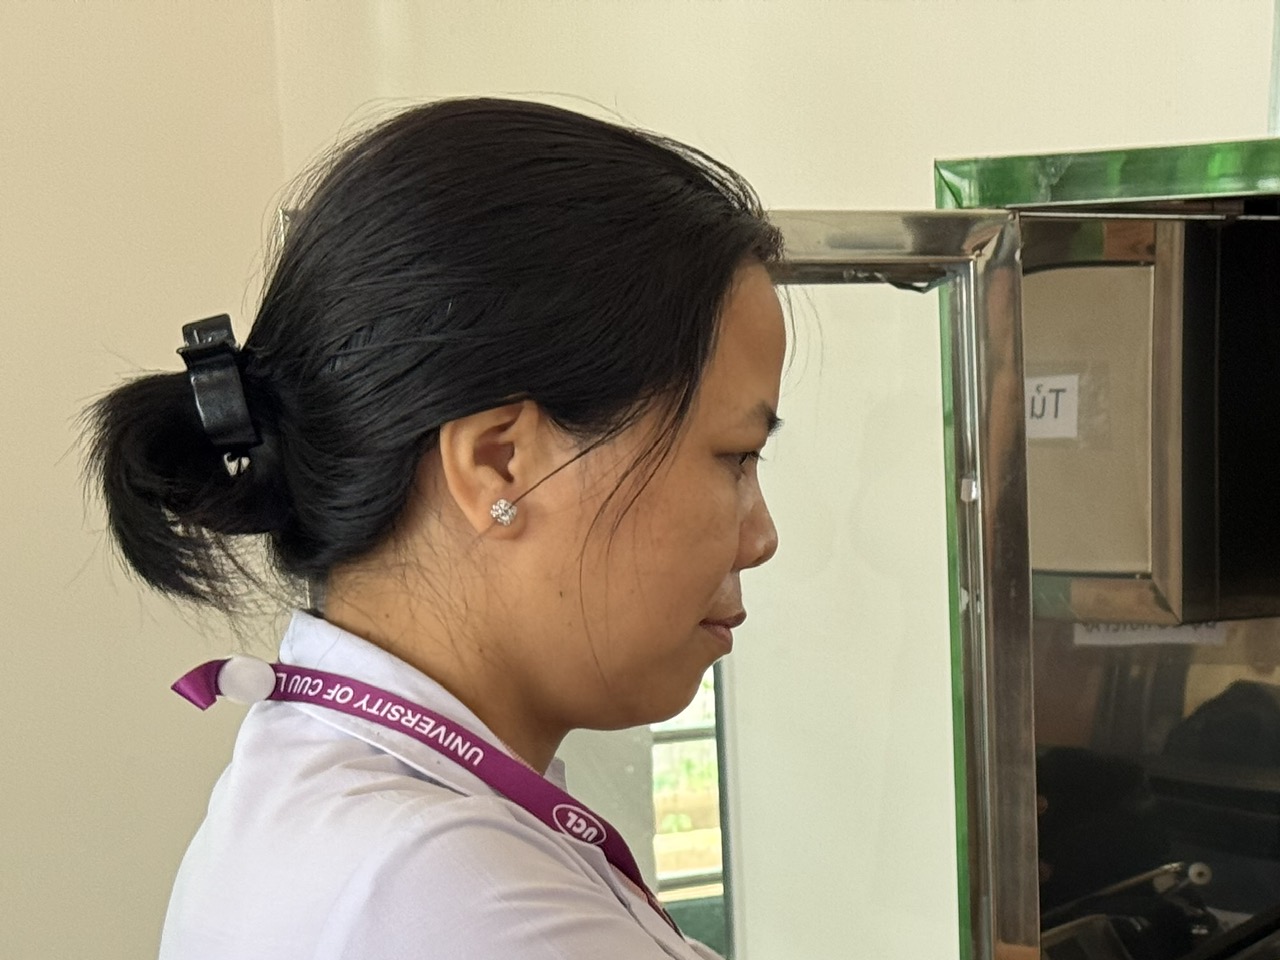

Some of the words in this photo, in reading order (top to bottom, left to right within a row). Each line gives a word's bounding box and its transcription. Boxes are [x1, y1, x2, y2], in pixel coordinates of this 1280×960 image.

[288, 675, 324, 697] CUU
[322, 682, 354, 704] OF
[353, 693, 485, 767] UNIVERSITY
[565, 810, 599, 843] UCL
